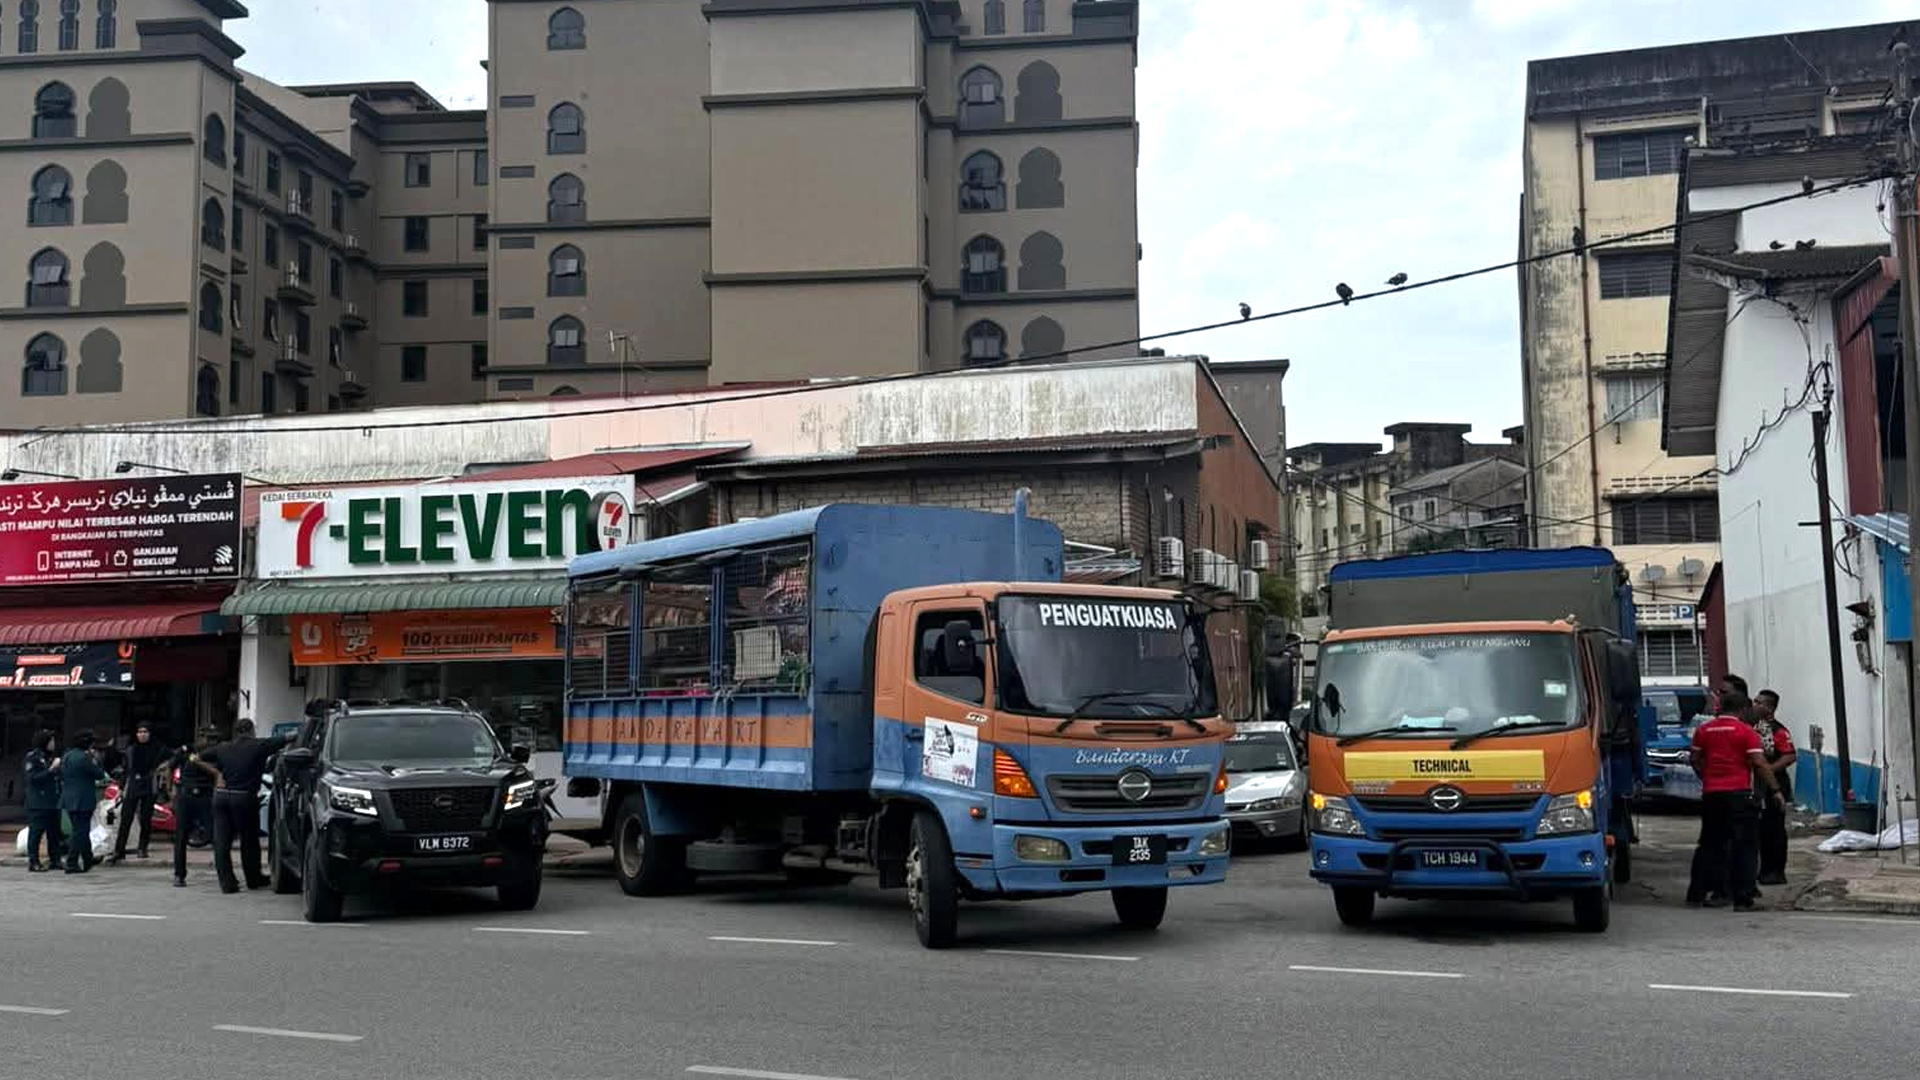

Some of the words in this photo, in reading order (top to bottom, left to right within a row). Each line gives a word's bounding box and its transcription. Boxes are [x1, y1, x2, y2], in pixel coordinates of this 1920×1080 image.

[262, 493, 286, 502] KEDAI
[18, 519, 56, 531] MAMPU
[57, 518, 84, 529] NILAI
[85, 516, 137, 528] TERBESAR
[138, 514, 175, 525] HARGA
[177, 511, 234, 524] TERENDAH
[61, 531, 106, 541] RANGKAIAN
[119, 529, 164, 539] TERPANTAS
[54, 550, 93, 560] INTERNET
[133, 547, 178, 557] GANJARAN
[54, 561, 82, 570] TANPA
[82, 560, 101, 569] HAD
[133, 557, 177, 567] EKSKLUSIF
[1039, 603, 1178, 630] PENGUATKUASA
[1679, 605, 1690, 618] P
[487, 631, 540, 645] PANTAS
[735, 720, 757, 742] KT
[1413, 759, 1472, 773] TECHNICAL
[442, 836, 470, 849] 6372
[1132, 837, 1149, 849] TAK
[1129, 849, 1151, 861] 2135
[1423, 852, 1446, 865] TCH
[1449, 852, 1477, 865] 1944
